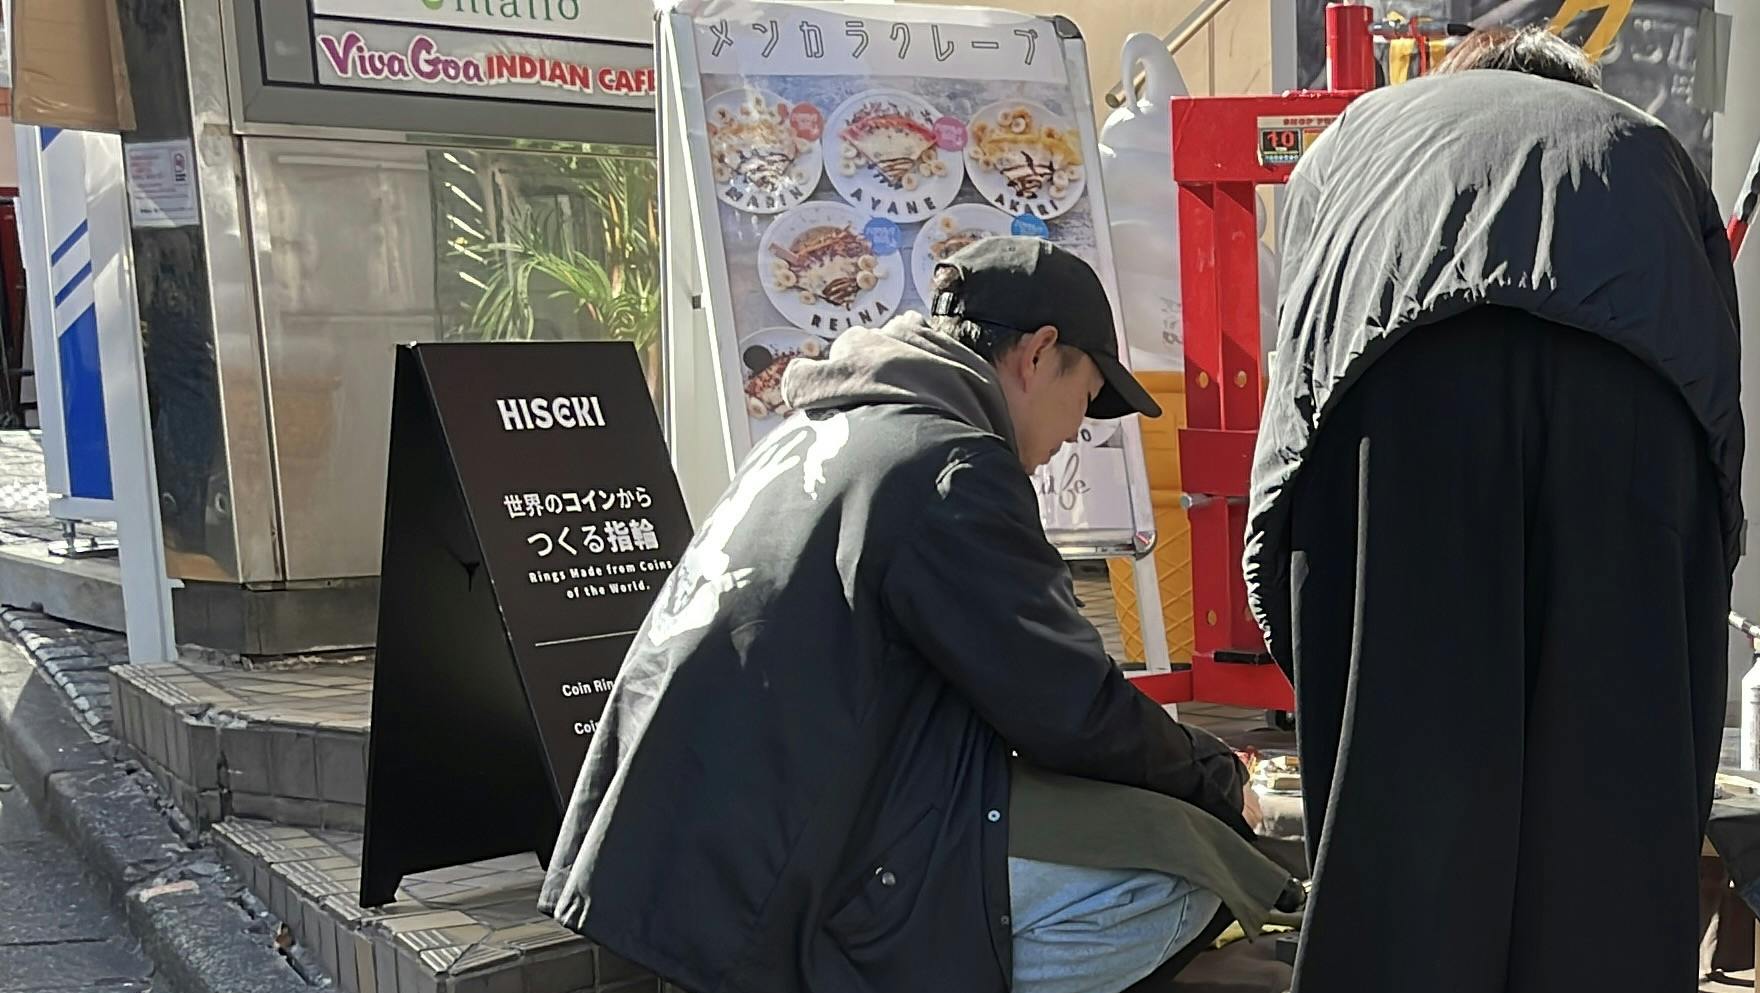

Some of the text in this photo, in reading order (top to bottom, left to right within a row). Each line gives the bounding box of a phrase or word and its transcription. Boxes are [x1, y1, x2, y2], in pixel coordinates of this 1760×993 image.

[709, 19, 1038, 66] メンカラクレープ
[317, 31, 411, 79] Viva
[409, 34, 485, 85] Goa
[485, 53, 593, 94] INDIAN
[850, 187, 937, 216] AYANE
[994, 193, 1059, 216] AKARI
[811, 301, 889, 331] REINA
[497, 396, 606, 431] HISEKI
[503, 487, 652, 519] 世界のコインから
[527, 519, 659, 557] つくる指輪
[528, 559, 673, 584] Rings Made from Coins
[566, 581, 650, 599] of the World.
[562, 682, 592, 697] Coin
